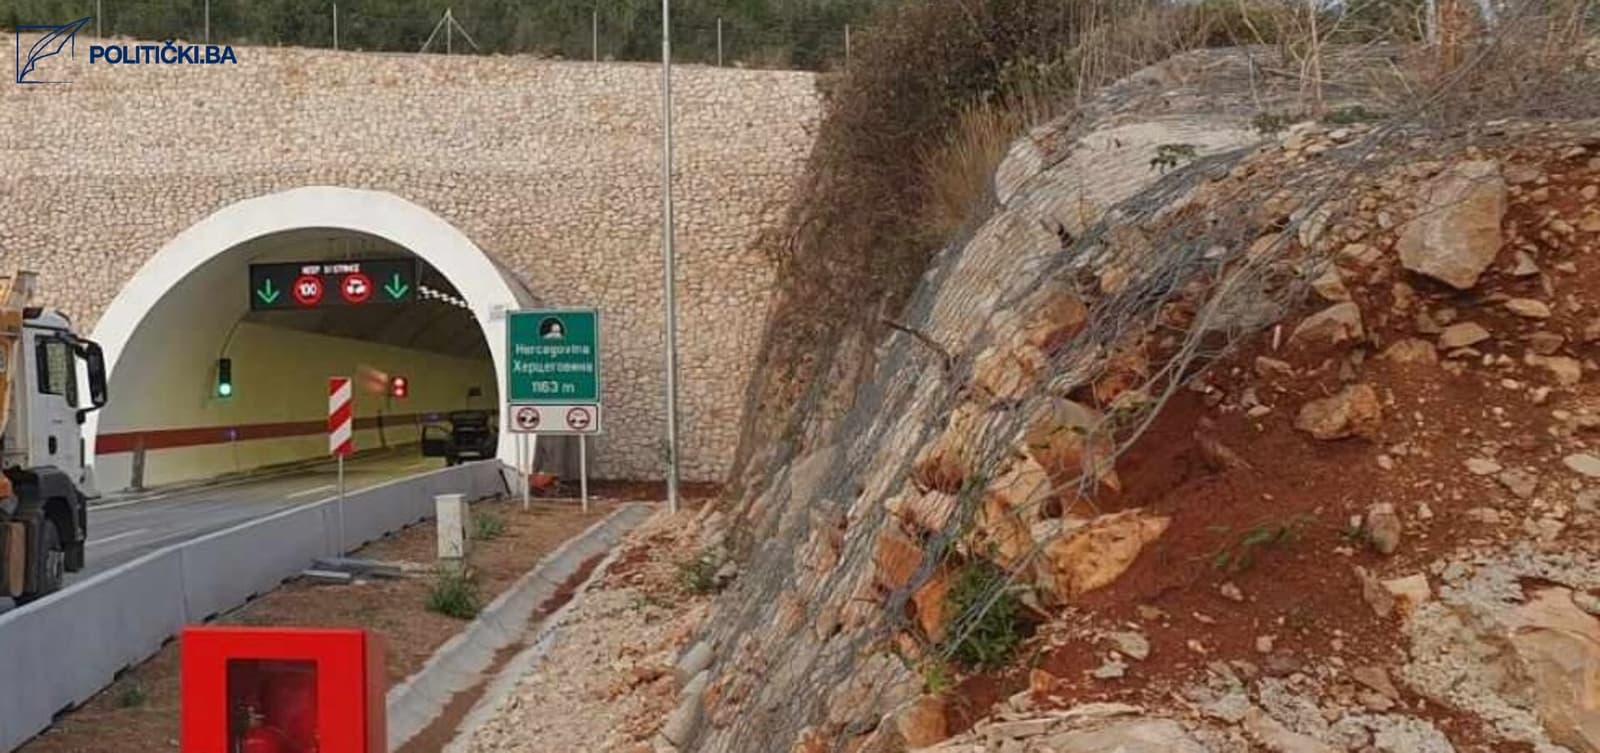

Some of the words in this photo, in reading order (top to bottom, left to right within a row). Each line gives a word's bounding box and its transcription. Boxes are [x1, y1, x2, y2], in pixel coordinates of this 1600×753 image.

[299, 282, 317, 296] 100
[515, 344, 590, 358] Hercegovina
[531, 381, 558, 393] 1163
[562, 383, 575, 393] m
